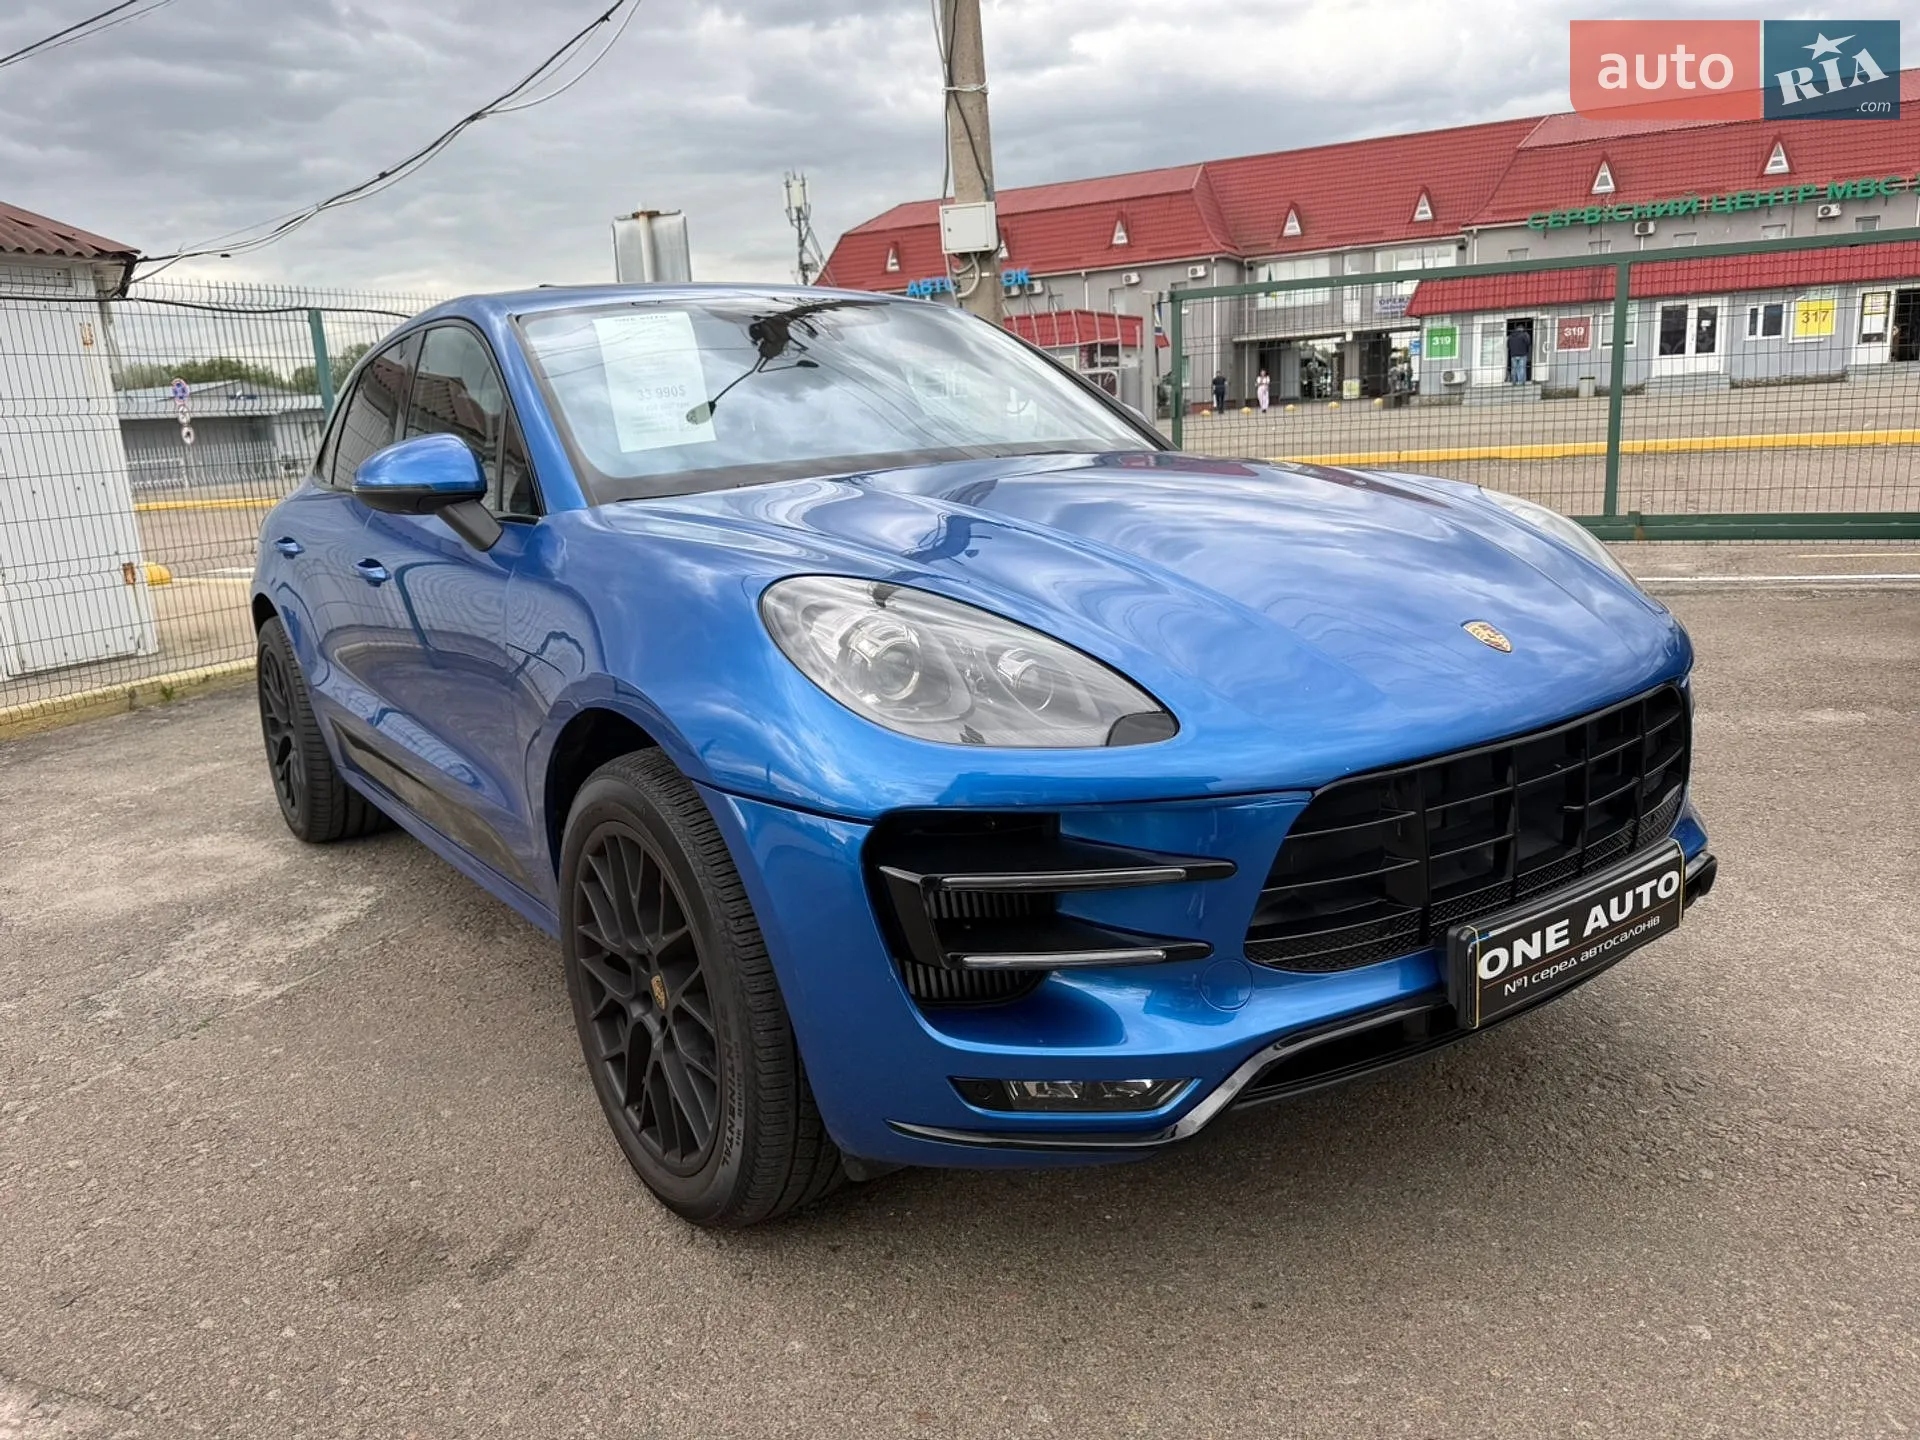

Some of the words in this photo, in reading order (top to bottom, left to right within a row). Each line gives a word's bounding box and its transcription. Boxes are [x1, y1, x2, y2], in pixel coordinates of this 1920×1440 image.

[1527, 191, 1700, 231] СЕРВІСНИЙ
[1711, 183, 1817, 215] ЦЕНТР
[1827, 175, 1901, 202] МВС
[1563, 326, 1585, 337] 319
[1801, 310, 1830, 324] 317
[1432, 336, 1452, 346] 319
[1478, 918, 1570, 980] ONE
[1583, 870, 1681, 938] AUTO
[1504, 974, 1528, 997] №1
[1531, 956, 1578, 984] серед
[1580, 915, 1661, 962] автосалонів
